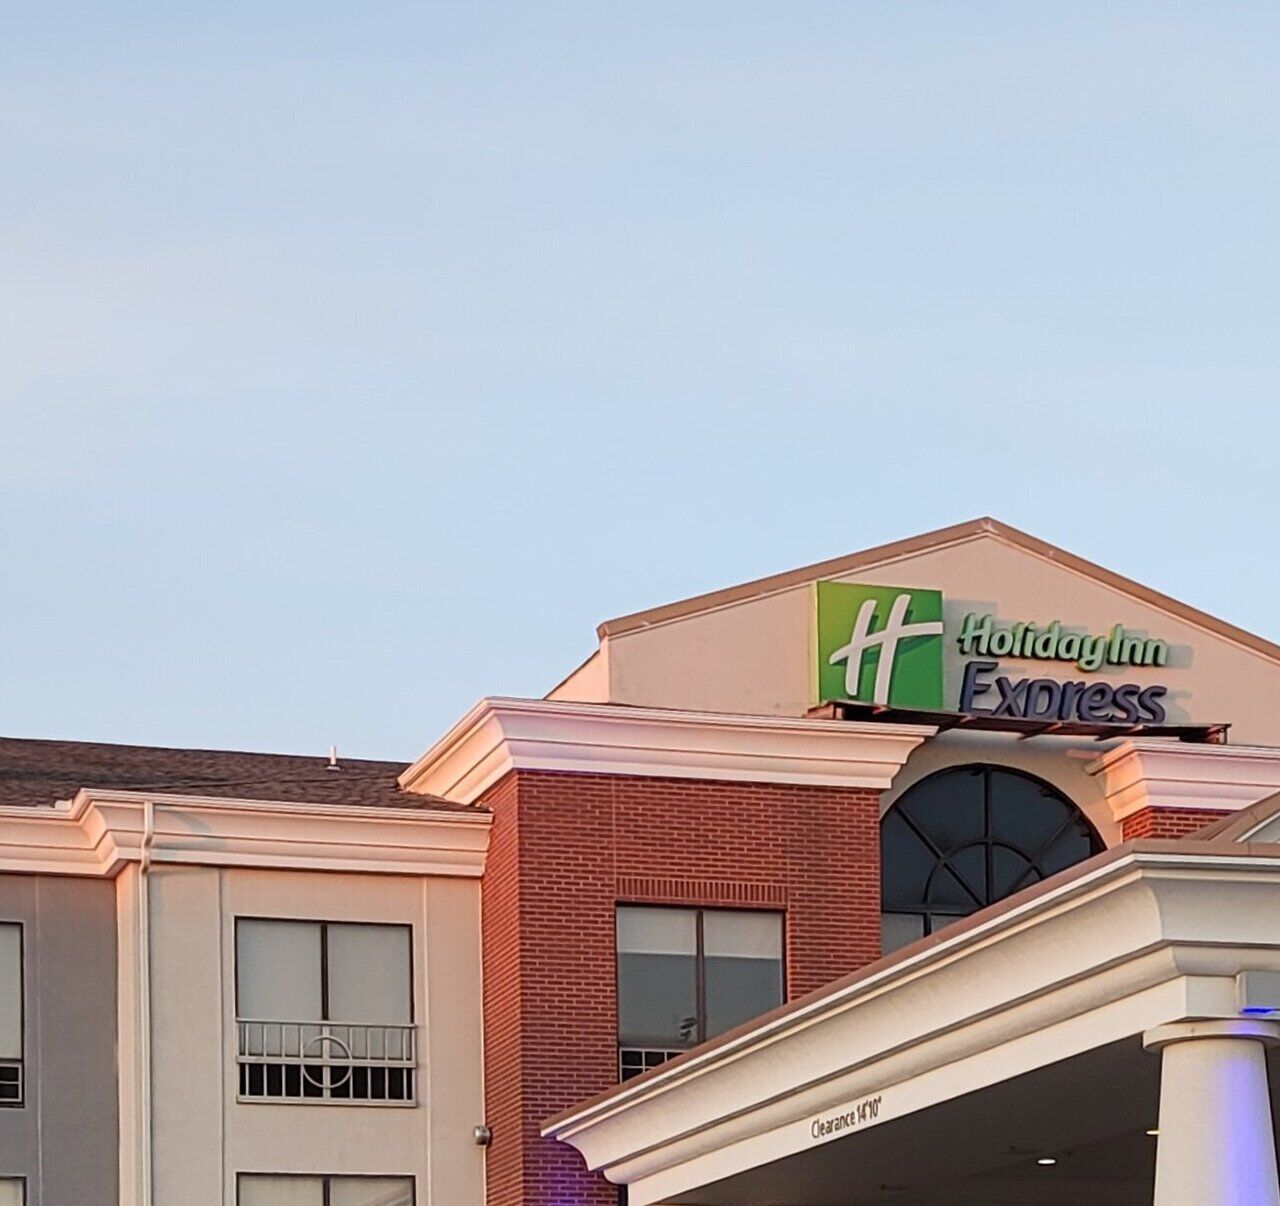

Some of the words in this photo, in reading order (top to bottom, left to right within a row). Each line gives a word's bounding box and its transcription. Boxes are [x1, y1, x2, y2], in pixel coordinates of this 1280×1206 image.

[958, 613, 1106, 672] Holiday
[1108, 623, 1168, 666] Inn
[959, 661, 1168, 724] Express
[811, 1110, 856, 1139] Clearance
